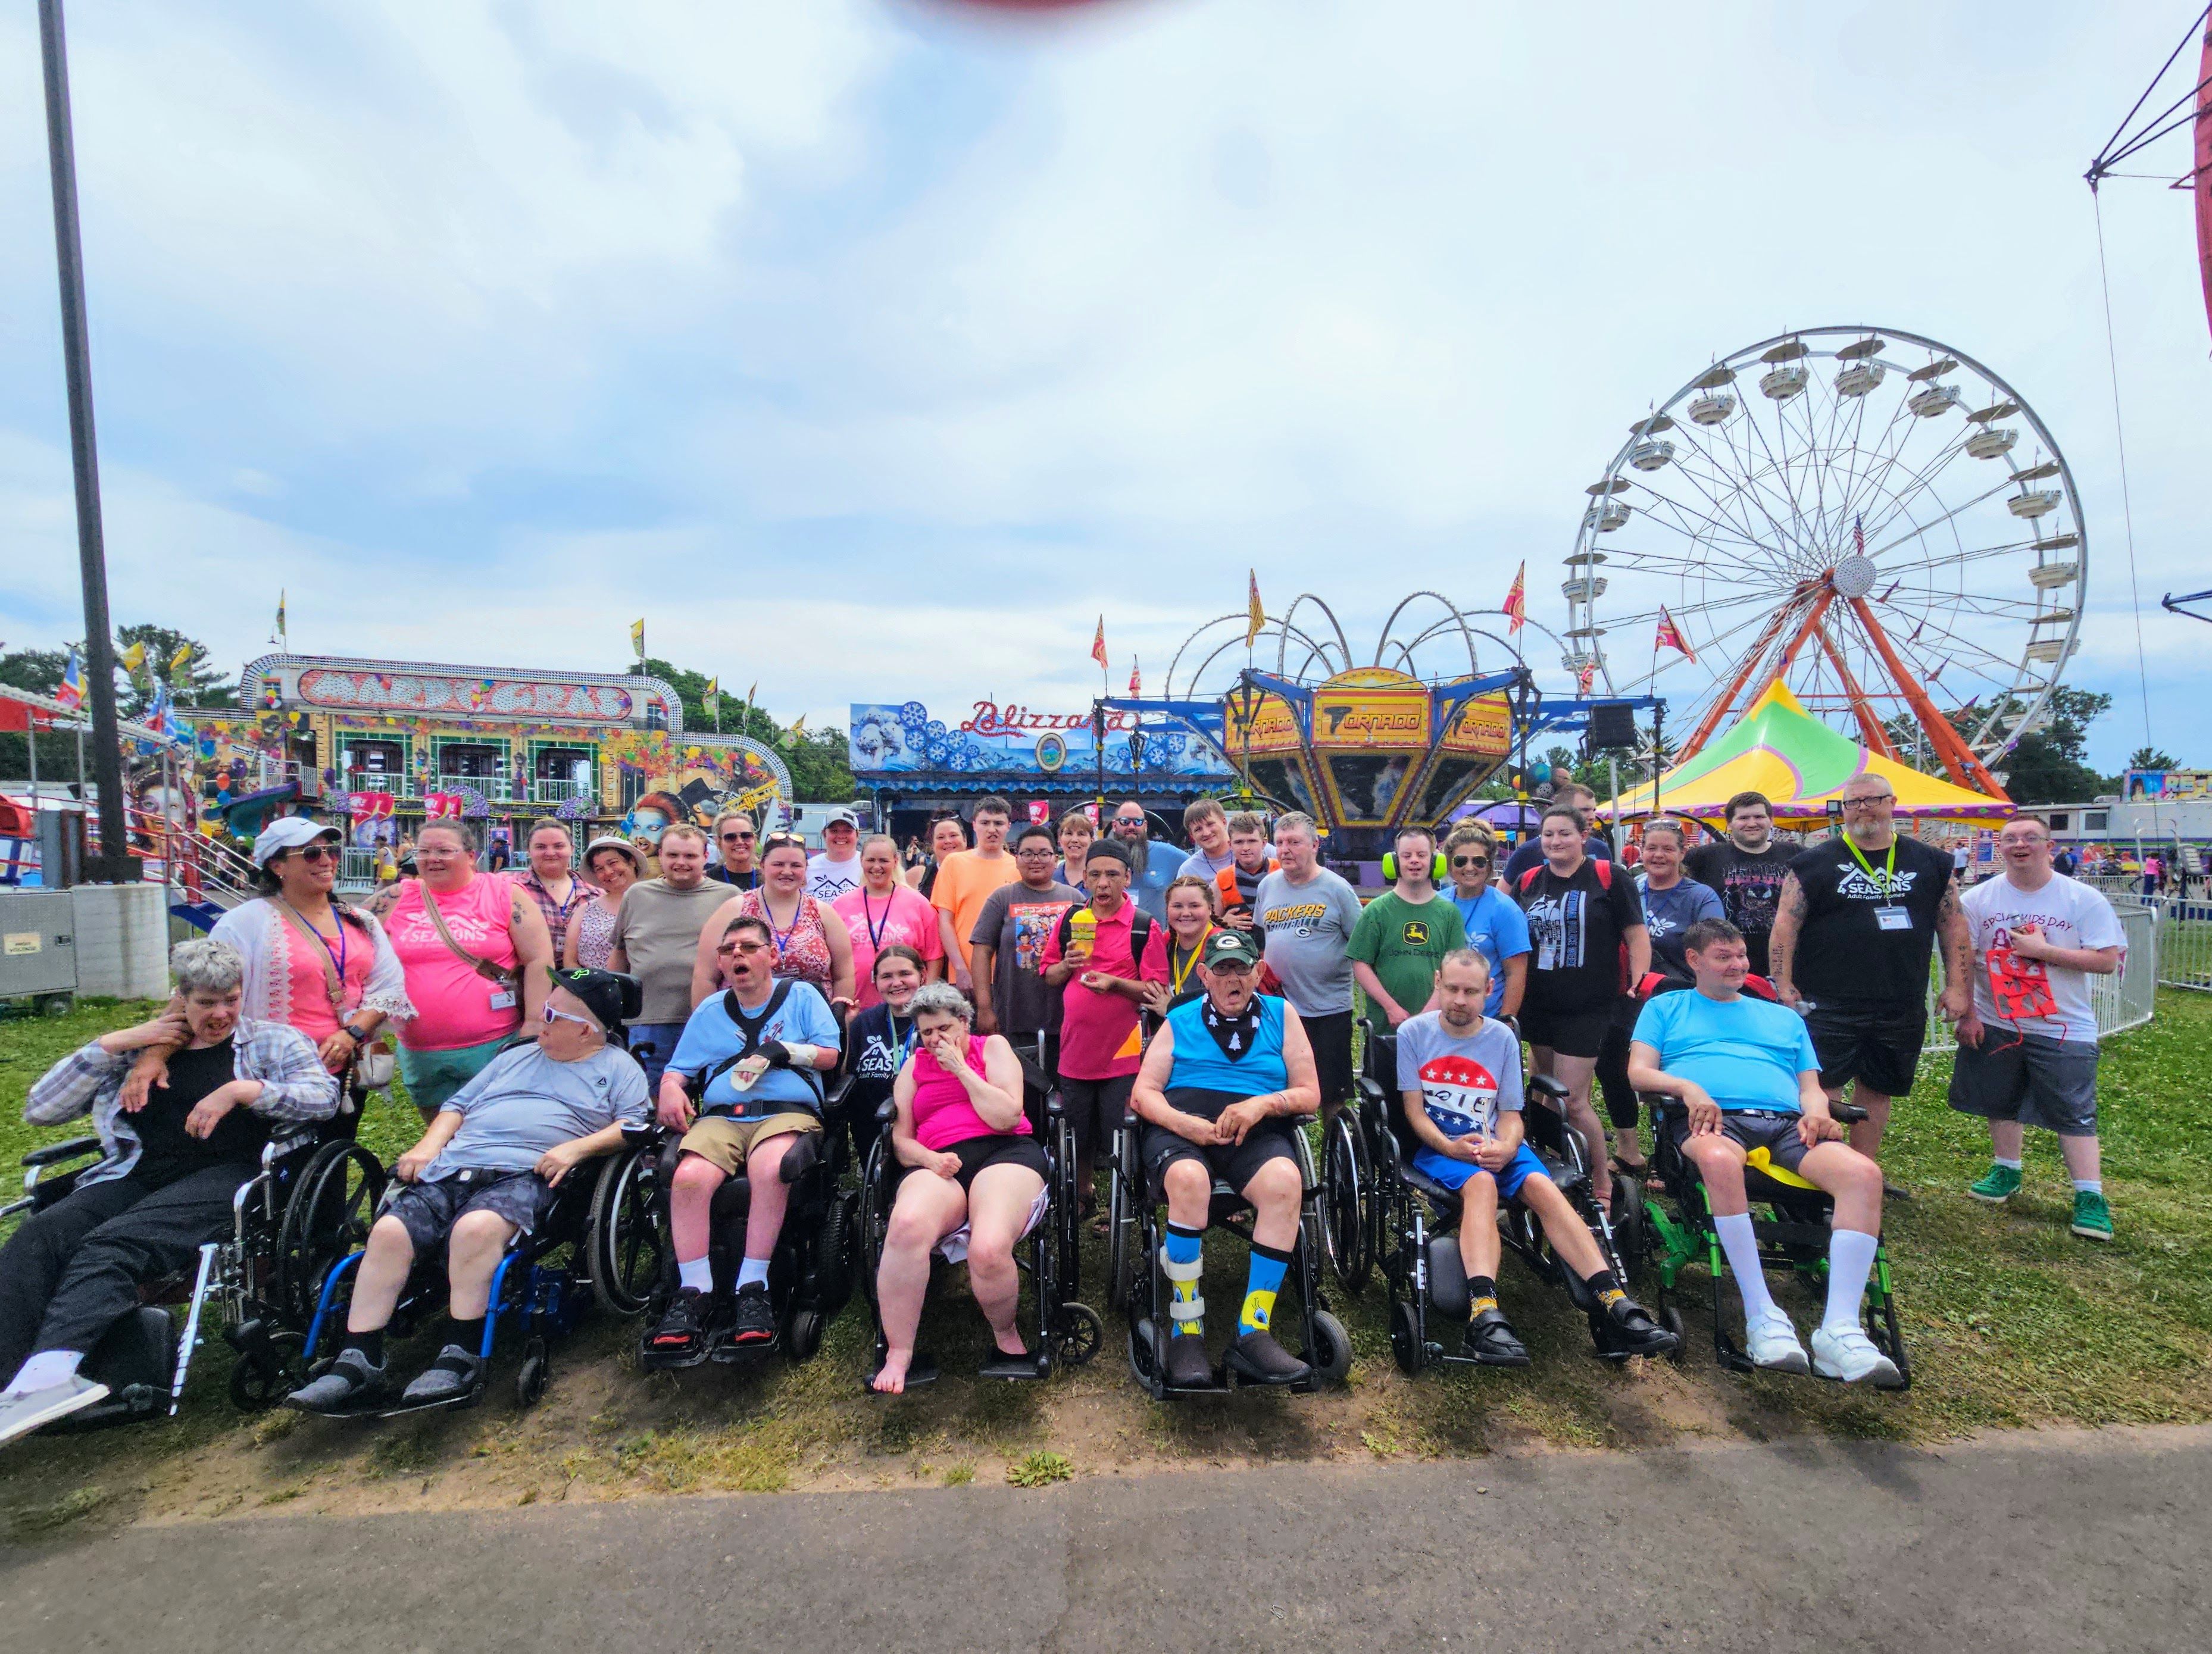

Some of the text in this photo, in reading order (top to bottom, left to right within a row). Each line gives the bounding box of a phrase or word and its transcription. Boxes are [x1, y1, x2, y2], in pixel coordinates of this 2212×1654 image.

[492, 683, 620, 717] GRAS
[1323, 706, 1421, 735] TORNADO
[817, 889, 854, 898] SEAS
[1848, 881, 1911, 894] SEASONS
[1265, 903, 1327, 924] PACKERS
[2047, 917, 2073, 931] DAY
[409, 930, 487, 942] SEAONS
[852, 932, 904, 943] SEAONS
[861, 1058, 895, 1072] SEAS
